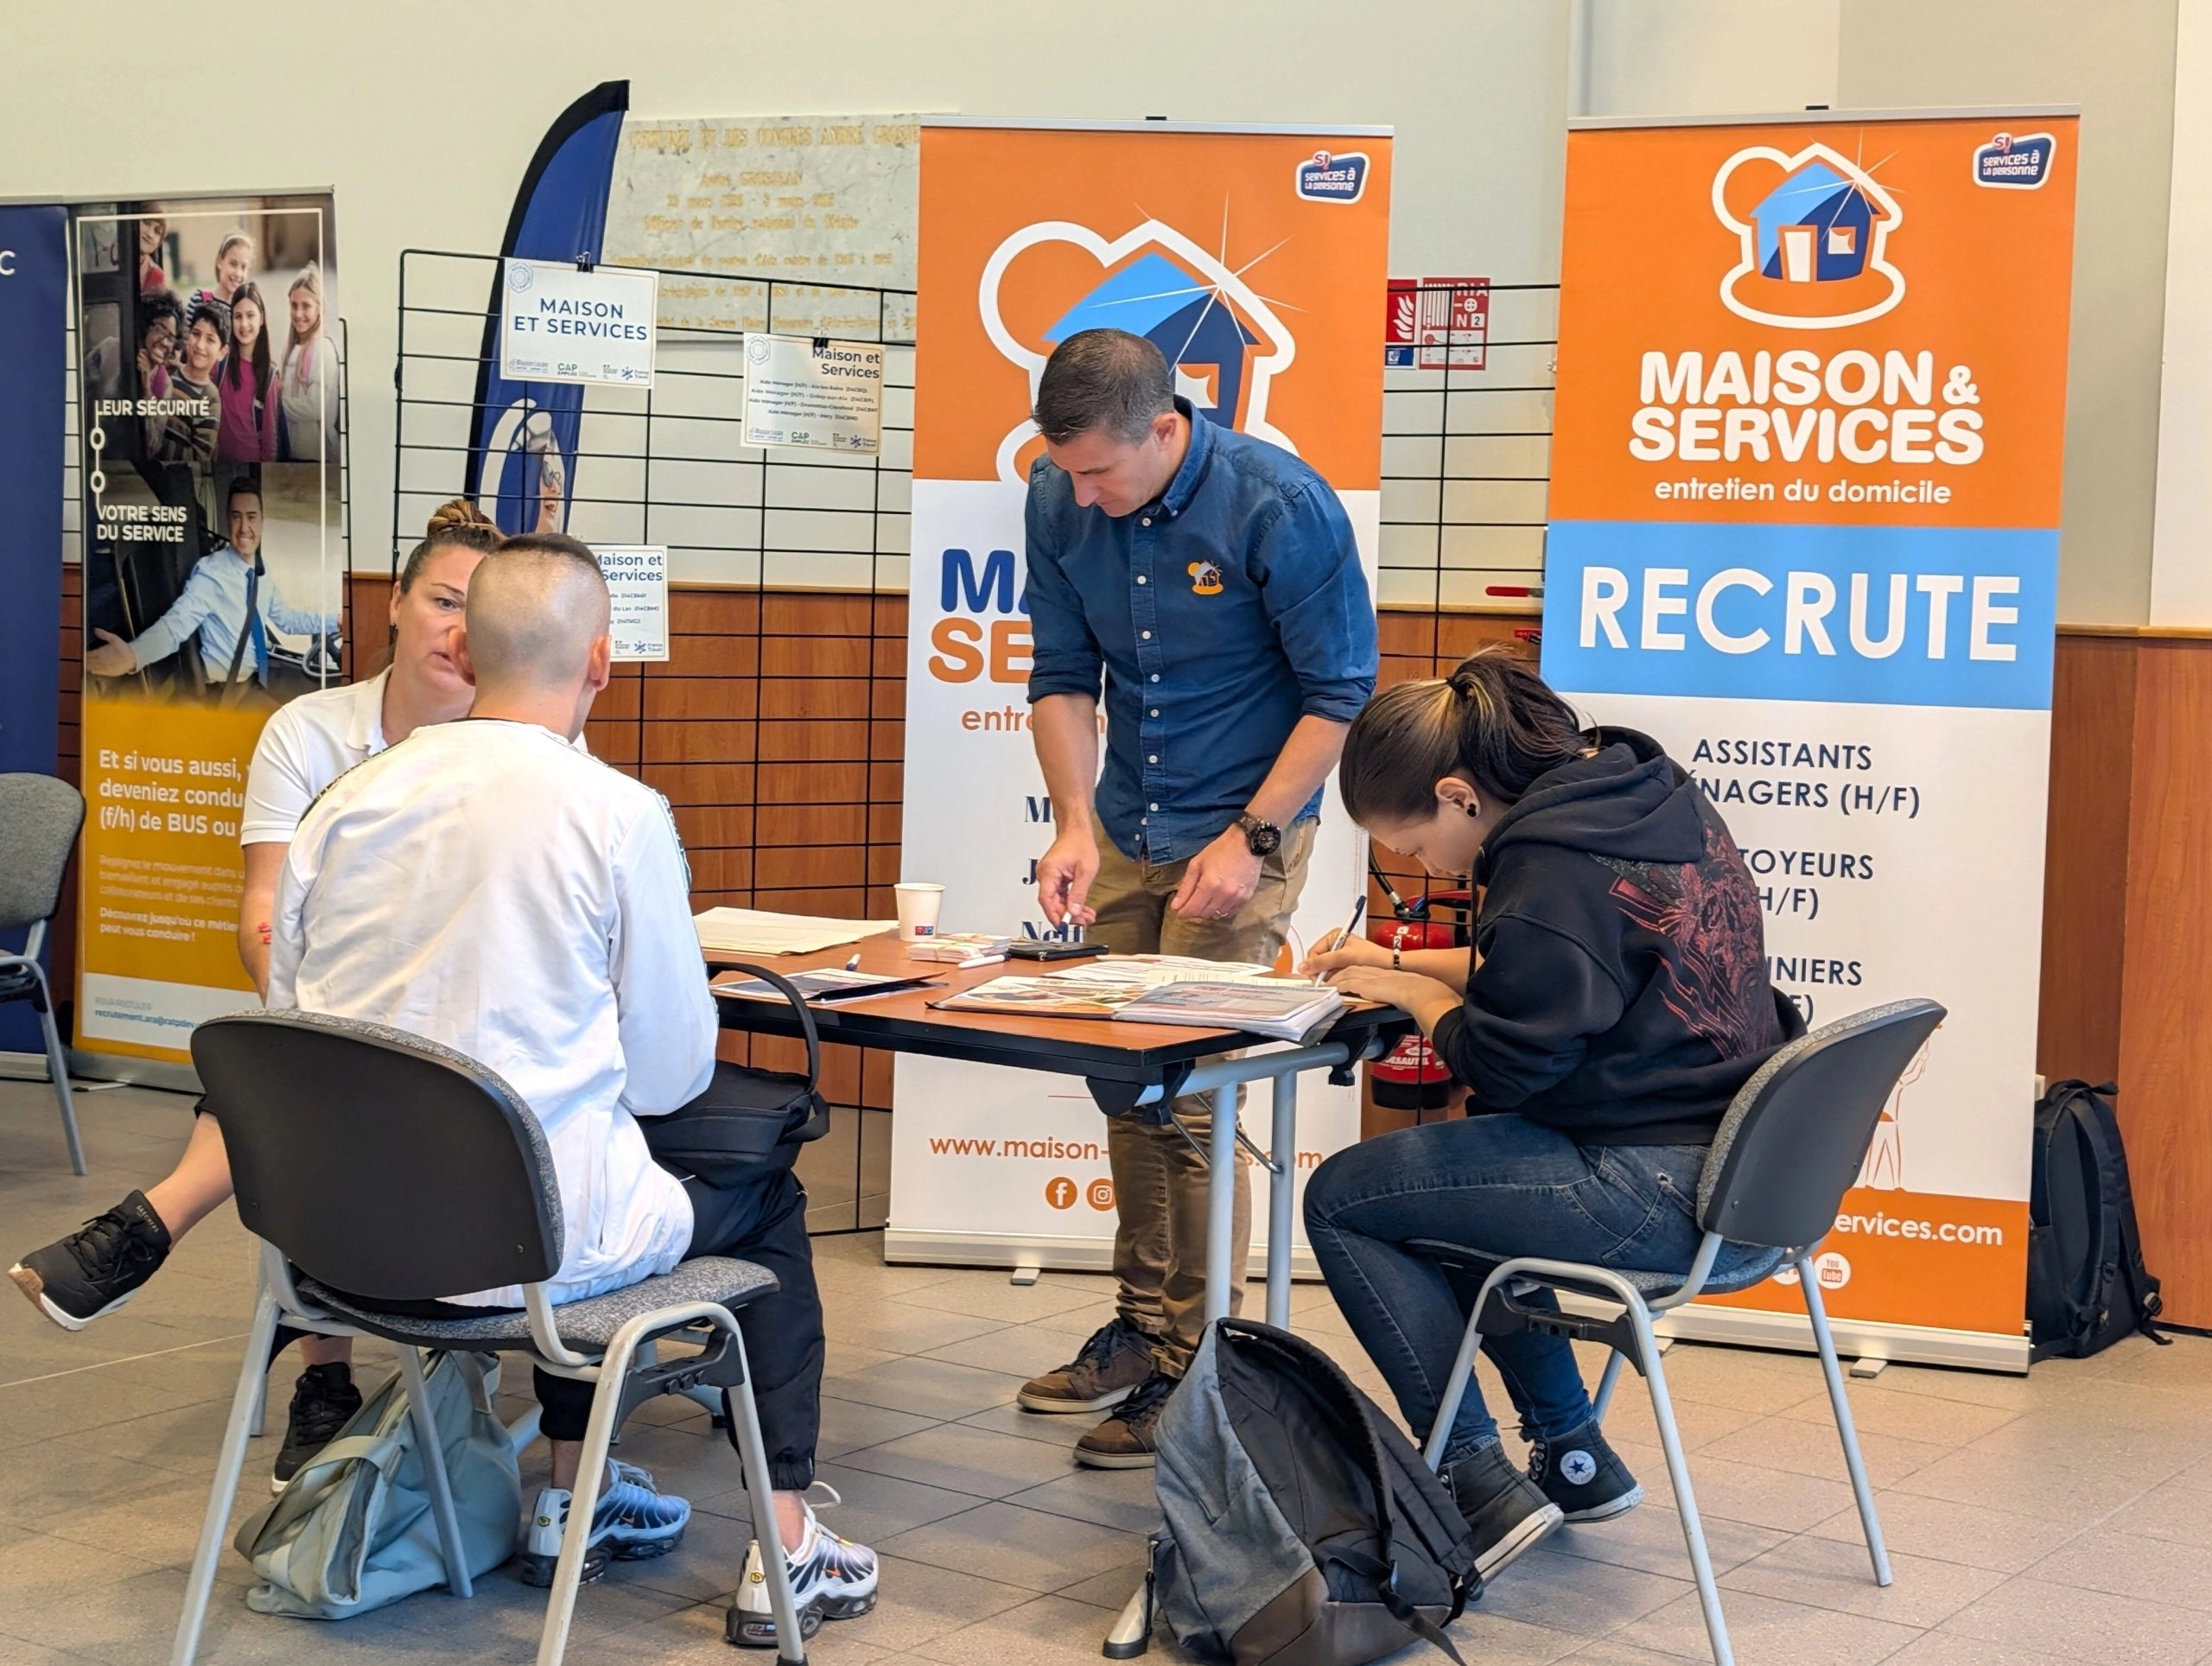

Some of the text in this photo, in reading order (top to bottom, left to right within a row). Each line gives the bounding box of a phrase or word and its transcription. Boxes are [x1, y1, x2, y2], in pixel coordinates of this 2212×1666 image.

[540, 297, 623, 319] MAISON
[514, 315, 539, 332] ET
[547, 318, 647, 340] SERVICES
[1474, 316, 1480, 326] 2
[812, 347, 880, 364] Maison et
[821, 363, 880, 378] Services
[1639, 350, 1980, 406] MAISON &
[95, 396, 210, 416] LEUR SÉCURITÉ
[1629, 406, 1985, 466] SERVICES
[1655, 477, 1952, 504] entretien du domicile
[97, 504, 187, 522] VOTRE SENS
[97, 524, 184, 543] DU SERVICE
[648, 555, 663, 566] et
[601, 569, 663, 581] Services
[941, 549, 1030, 614] M
[1580, 566, 2020, 661] RECRUTE
[99, 749, 241, 782] Et si vous aussi,
[1692, 739, 1872, 771] ASSISTANTS
[99, 778, 179, 803] deveniez
[1840, 784, 1920, 819] (H/F)
[100, 805, 236, 836] (f/h) de BUS ou
